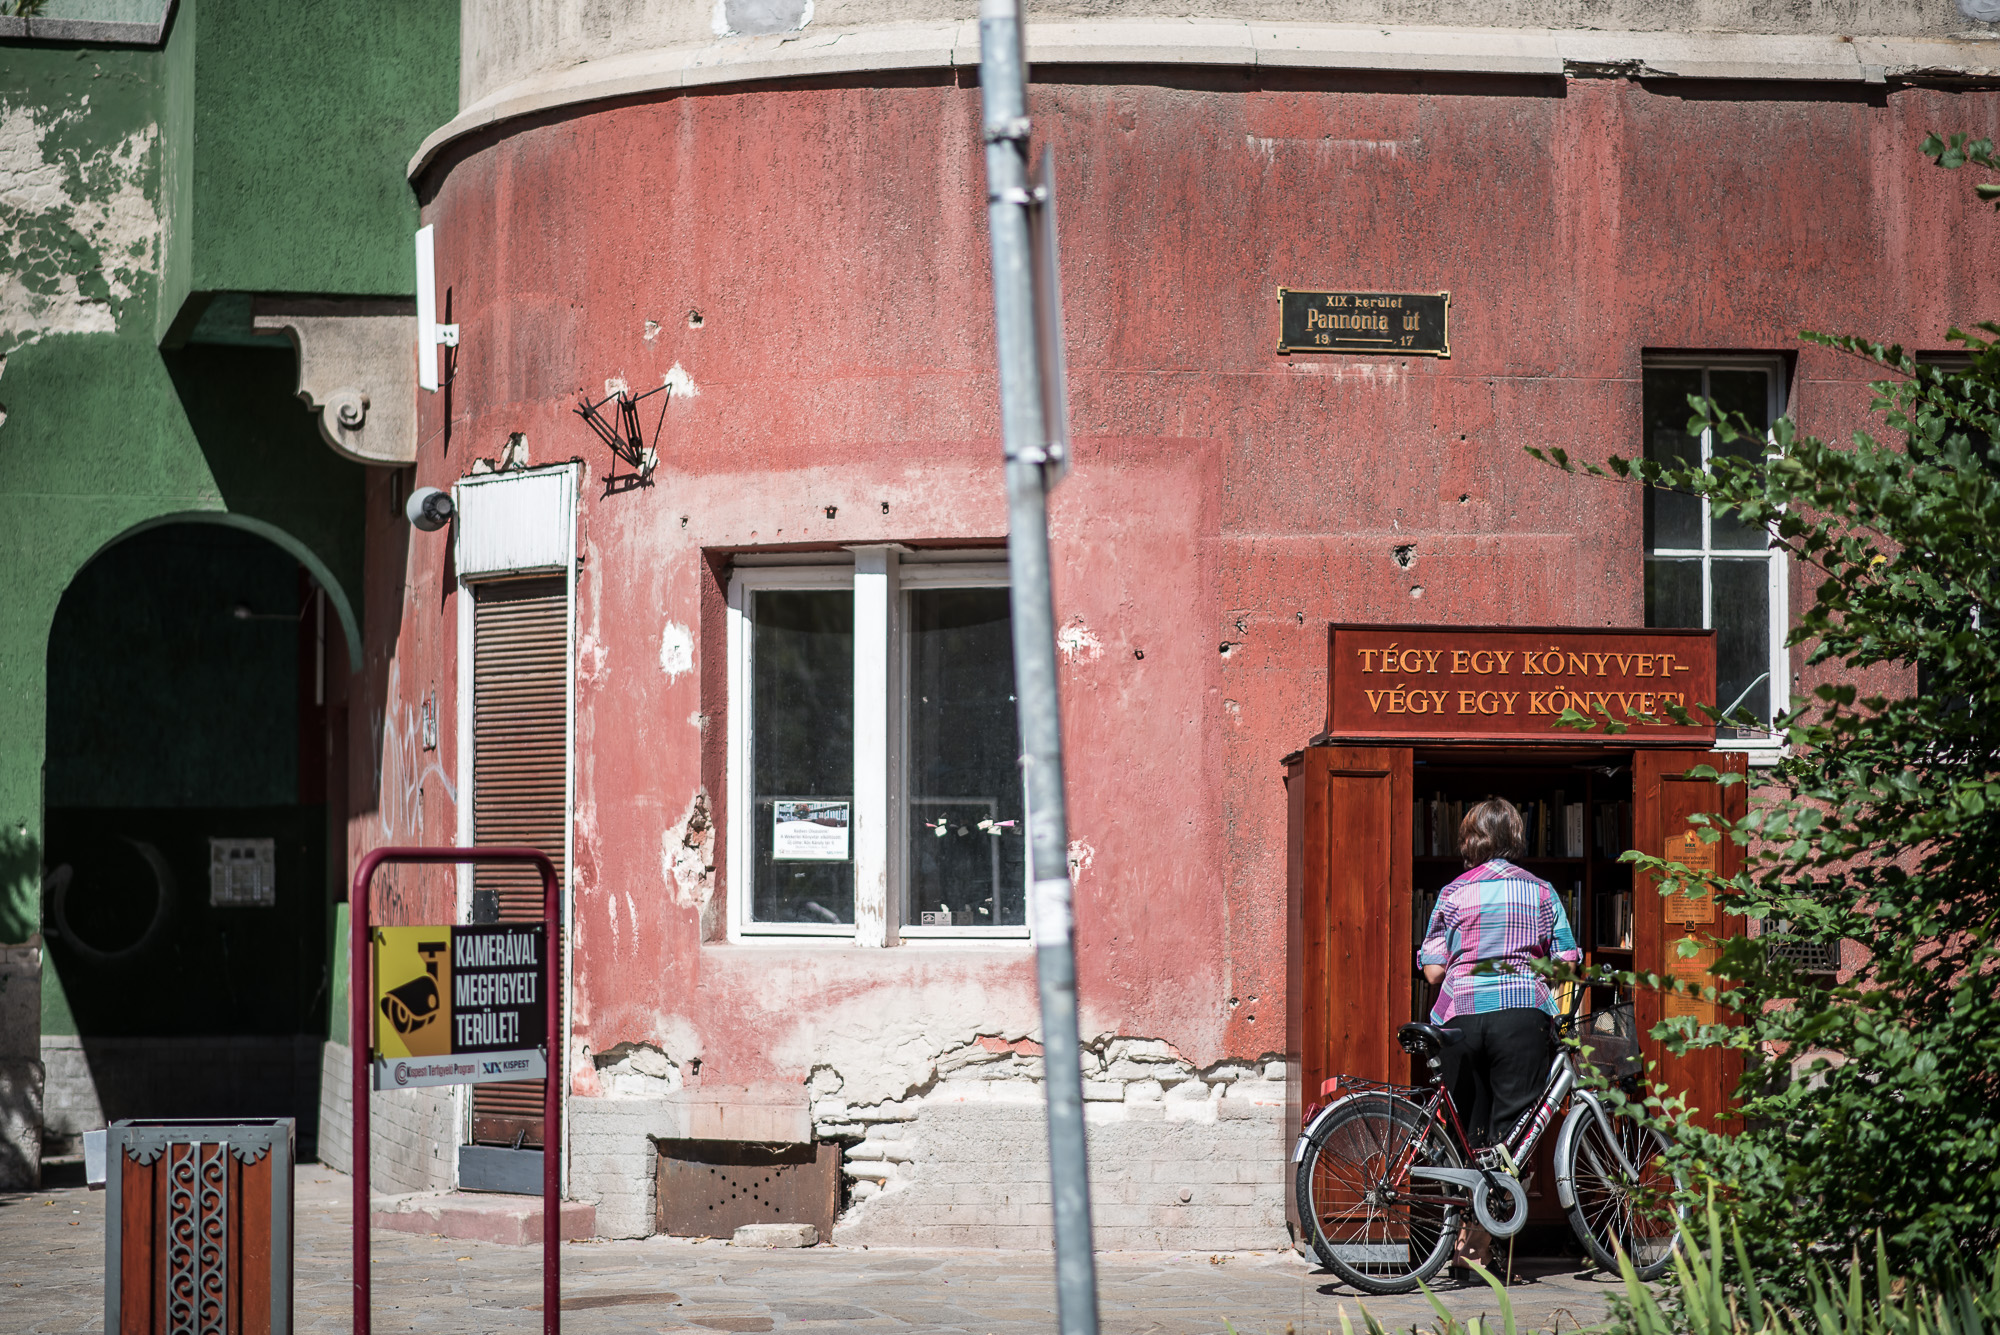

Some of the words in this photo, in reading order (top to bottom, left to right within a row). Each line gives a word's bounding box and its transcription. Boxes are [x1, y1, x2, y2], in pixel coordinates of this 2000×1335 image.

[1325, 295, 1352, 308] XIX.
[1355, 296, 1403, 309] kerület
[1306, 308, 1389, 331] Pannónia
[1402, 310, 1421, 332] út
[1357, 642, 1443, 674] TÉGY
[1450, 650, 1515, 675] EGY
[1364, 683, 1450, 714] VÉGY
[1457, 690, 1521, 715] EGY
[1528, 685, 1685, 716] KÖNYVET!
[455, 928, 538, 968] KAMERÁVAL
[455, 971, 538, 1007] MEGFIGYELT
[455, 1007, 519, 1046] TERÜLET!
[407, 1066, 427, 1078] Kispesti
[454, 1063, 476, 1076] Program
[482, 1061, 502, 1075] XIX
[503, 1059, 530, 1070] KISPEST
